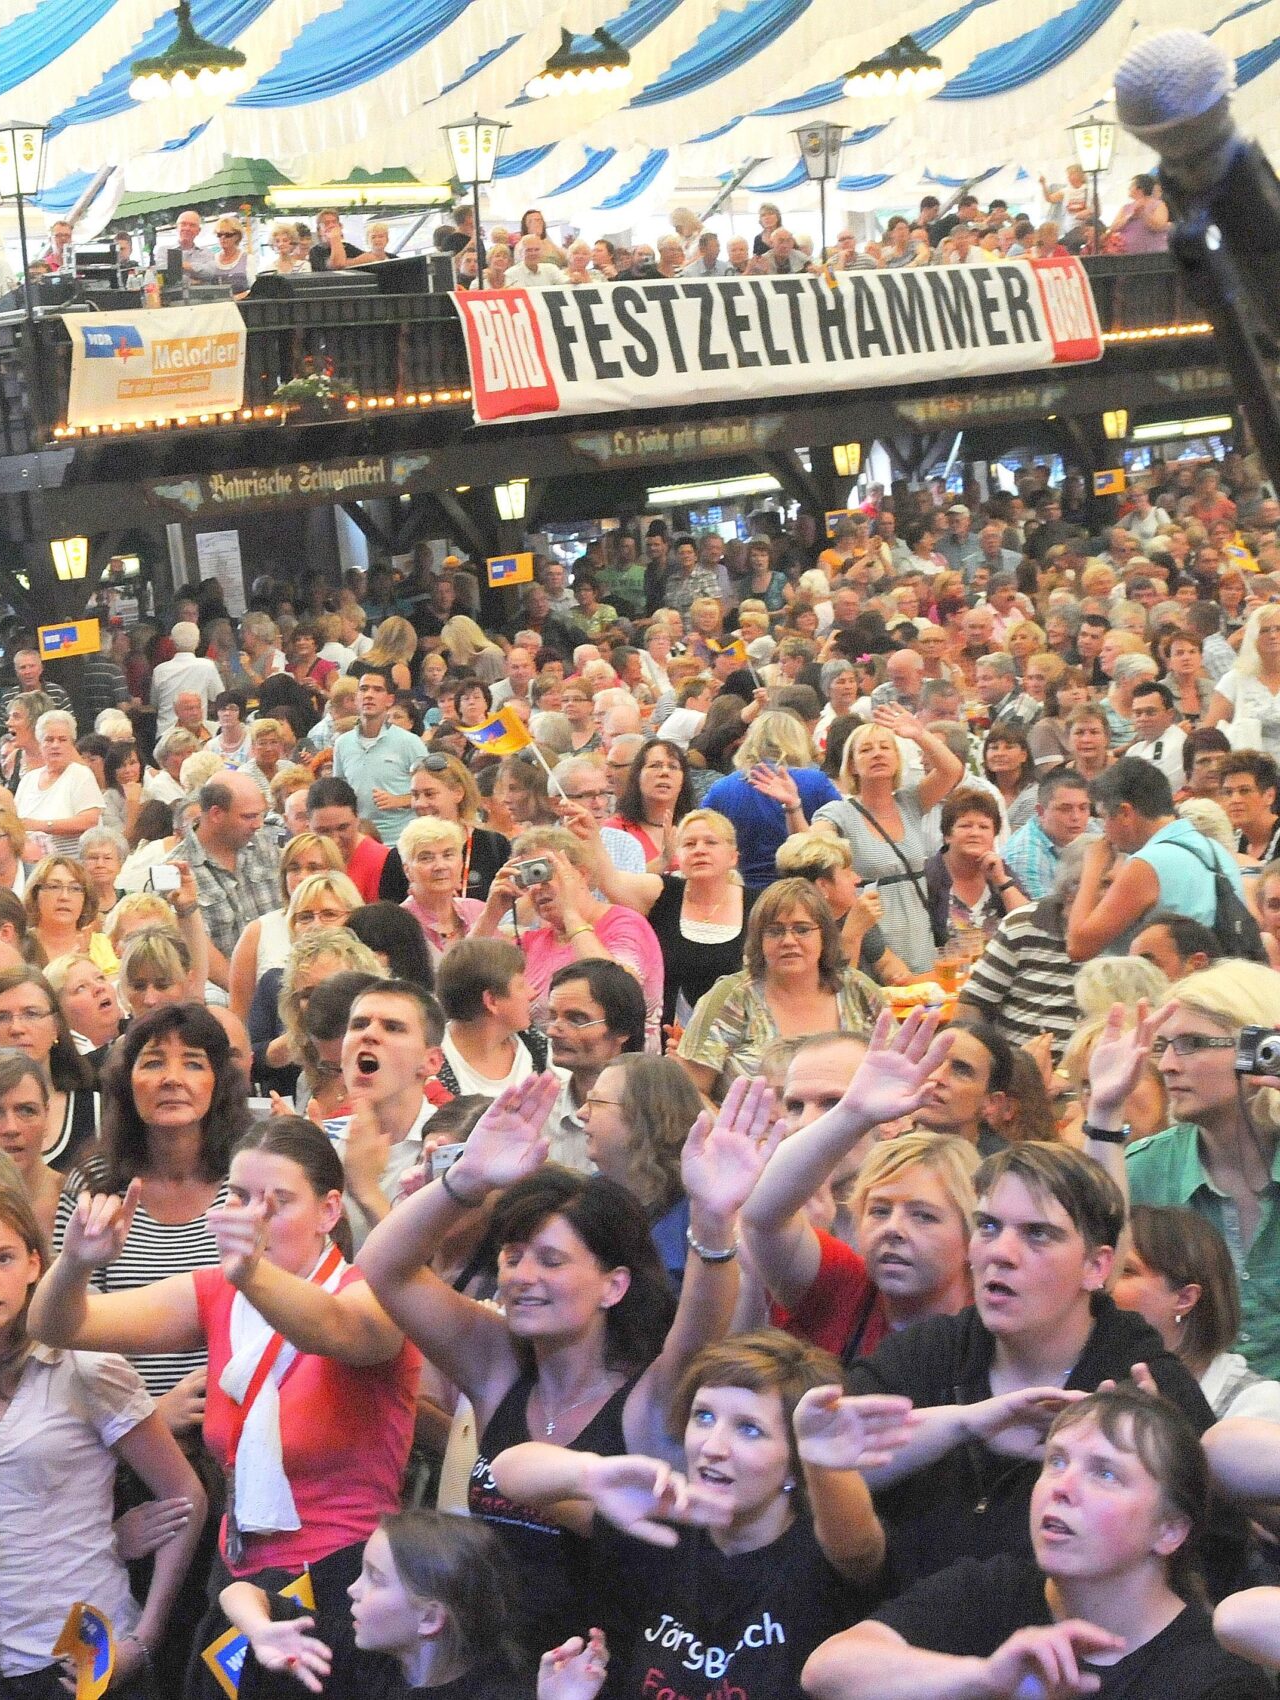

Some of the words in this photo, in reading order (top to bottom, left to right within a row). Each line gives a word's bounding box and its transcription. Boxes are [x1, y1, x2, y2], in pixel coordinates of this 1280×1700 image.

[153, 338, 241, 371] Melodien
[467, 298, 548, 393] Bild
[541, 266, 1042, 382] FESTZELTHAMMER
[1037, 265, 1095, 342] Bild
